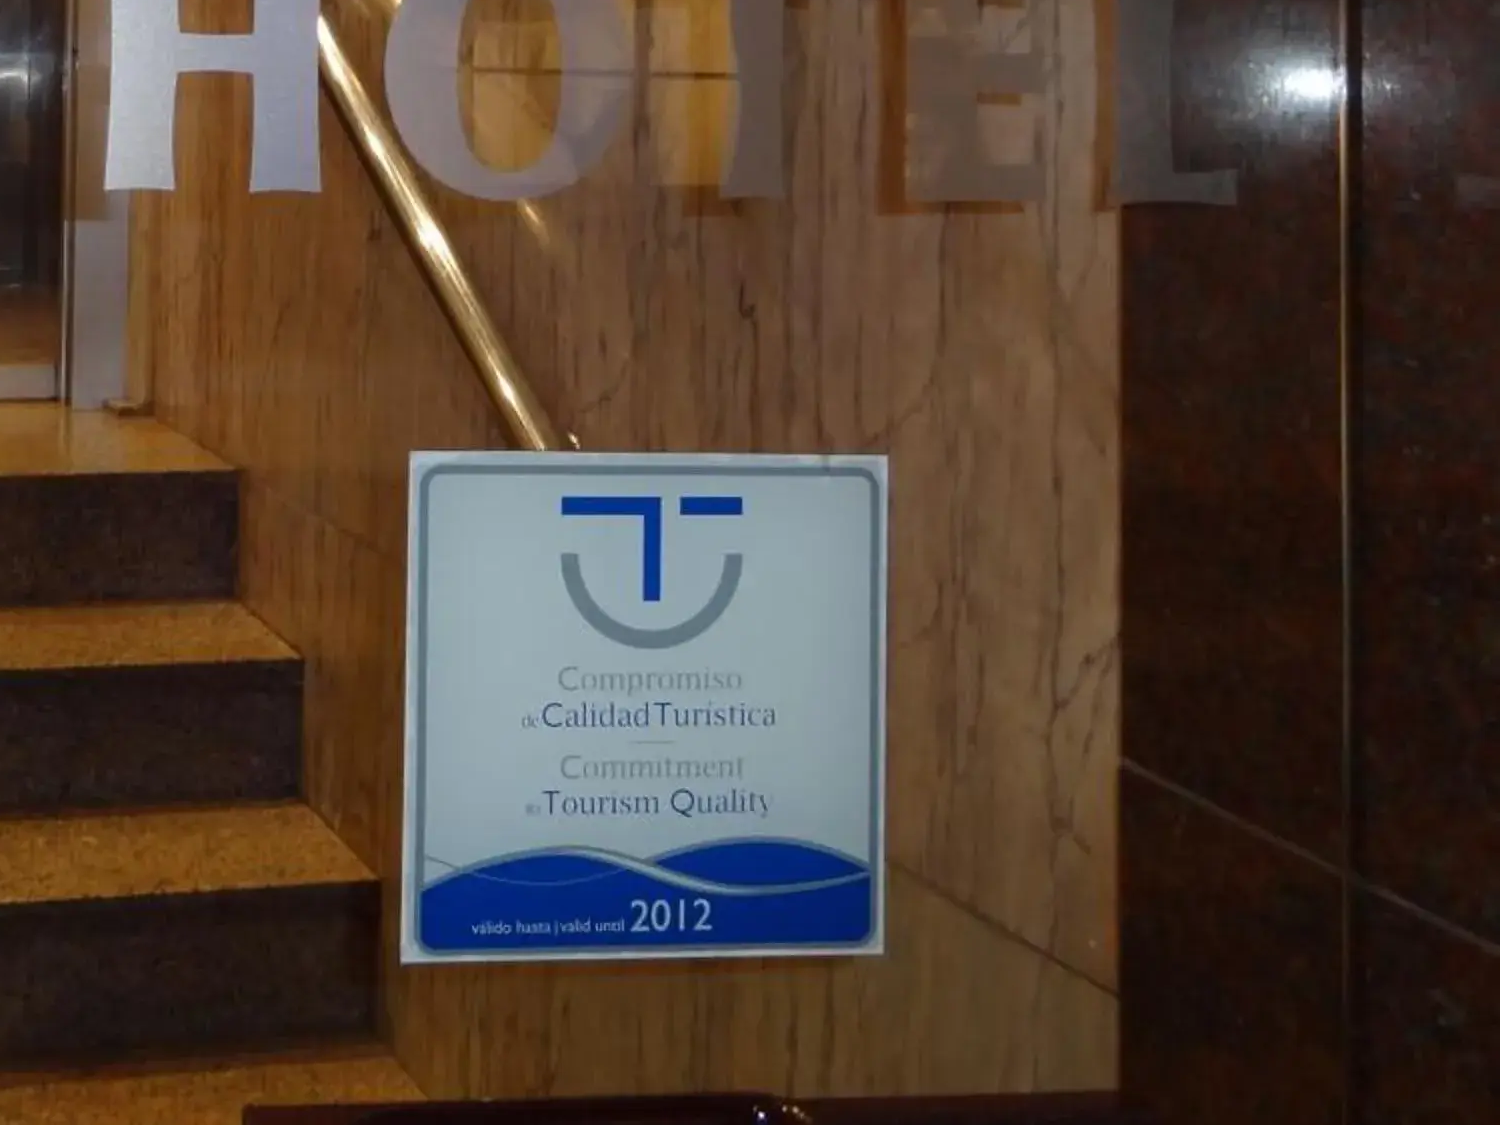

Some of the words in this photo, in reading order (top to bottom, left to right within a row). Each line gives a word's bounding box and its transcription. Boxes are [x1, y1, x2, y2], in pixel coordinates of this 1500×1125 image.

[557, 665, 743, 696] Compromiso
[541, 701, 650, 728] Calidad
[559, 754, 745, 780] Commitment
[541, 789, 660, 816] Tourism
[670, 788, 772, 818] Quality
[630, 898, 713, 933] 2012
